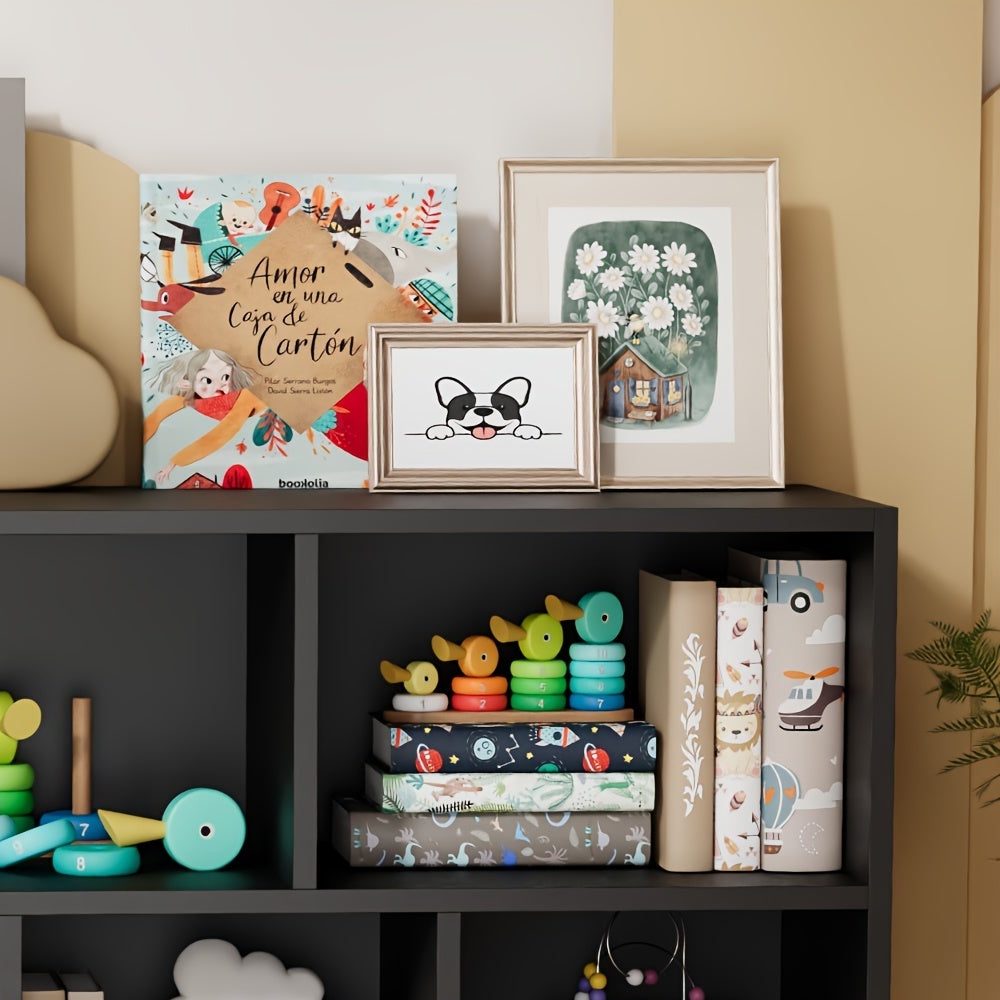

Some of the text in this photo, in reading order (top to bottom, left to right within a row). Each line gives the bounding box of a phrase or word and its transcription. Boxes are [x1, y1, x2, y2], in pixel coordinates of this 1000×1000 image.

[249, 256, 325, 290] Amor
[273, 289, 343, 304] en una
[228, 301, 308, 336] Caja de
[257, 324, 363, 367] Cartón
[539, 683, 547, 692] 5
[480, 699, 487, 708] 2
[537, 699, 544, 709] 4
[597, 699, 603, 708] 7
[79, 823, 90, 837] 7
[12, 840, 24, 855] 9
[76, 856, 86, 871] 8
